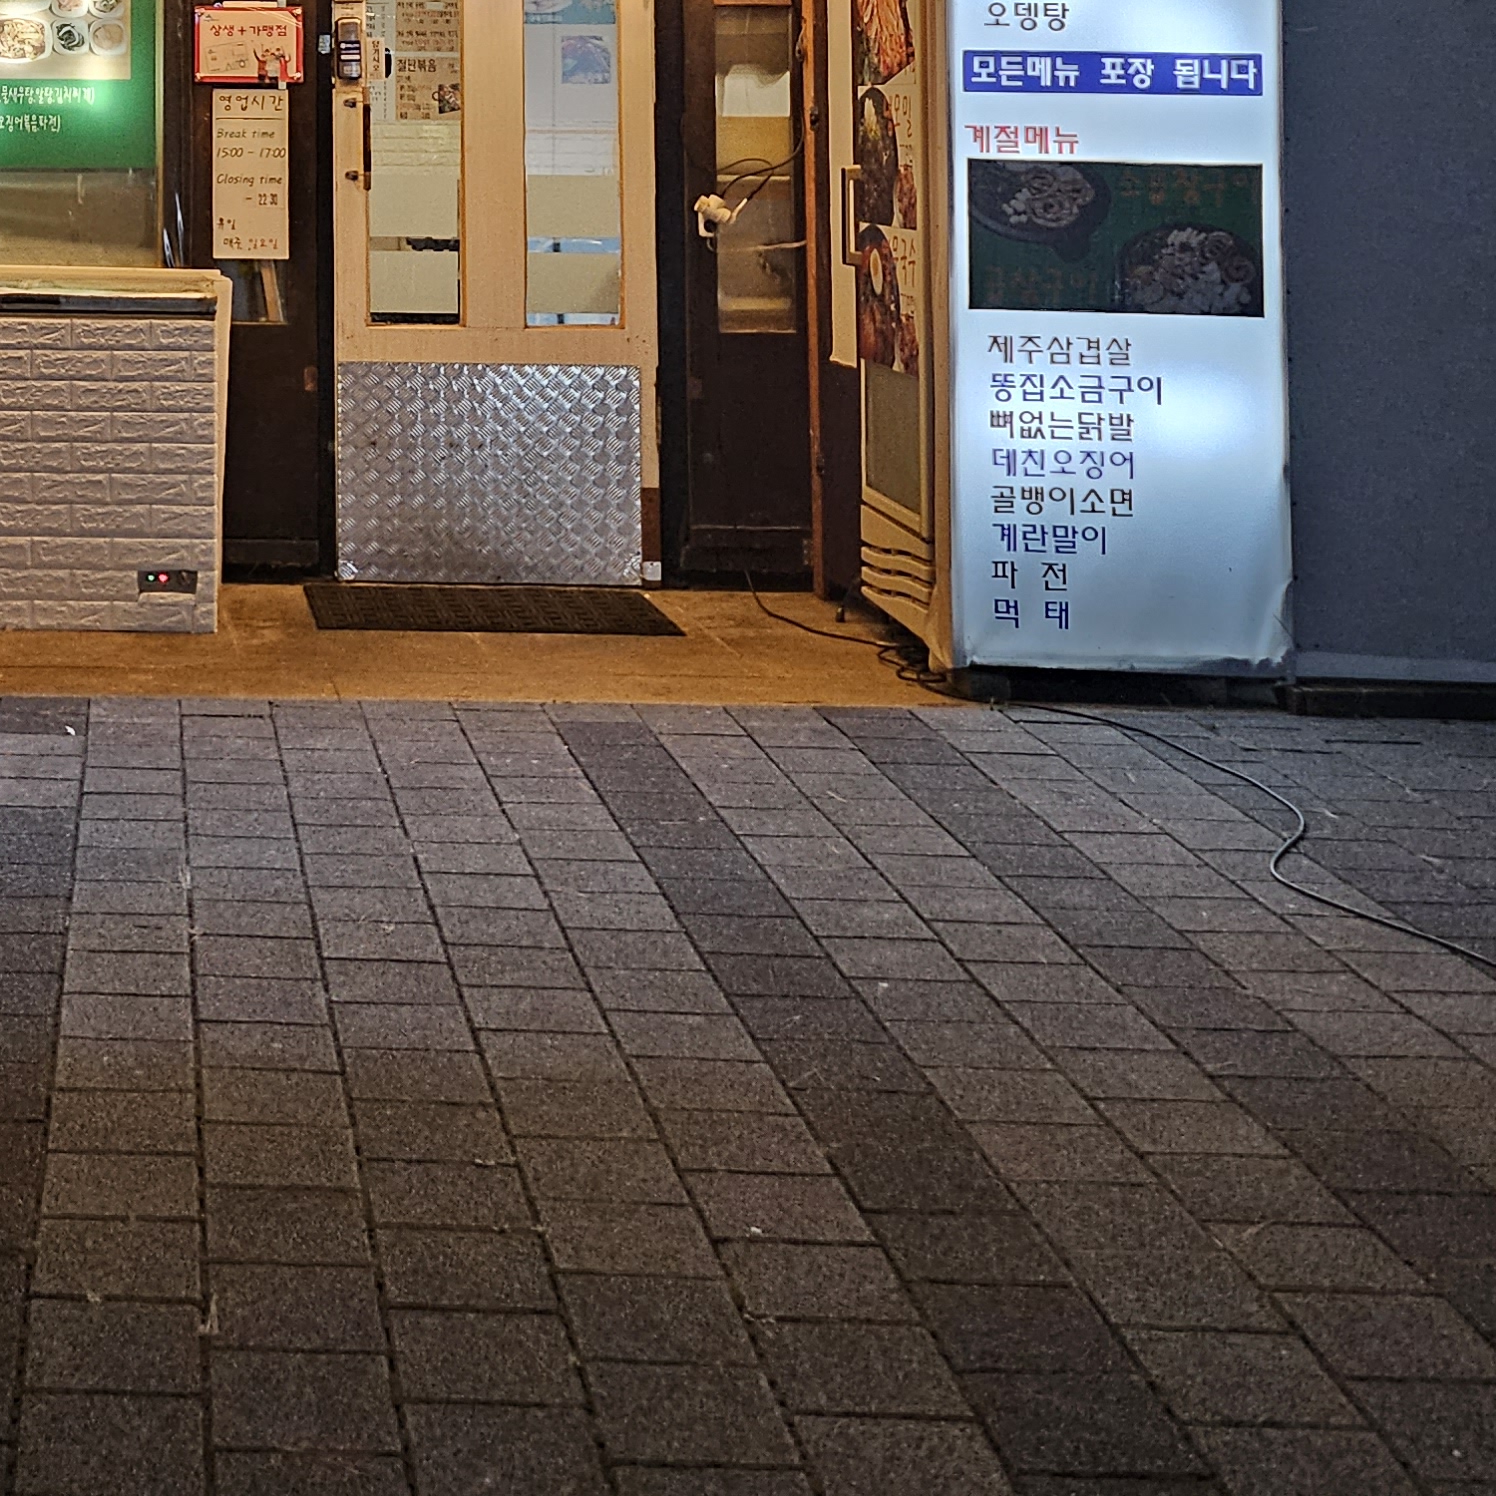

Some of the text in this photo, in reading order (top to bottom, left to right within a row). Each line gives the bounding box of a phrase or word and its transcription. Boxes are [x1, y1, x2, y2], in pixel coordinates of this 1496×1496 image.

[209, 24, 235, 37] 상생
[248, 24, 288, 37] 가맹점
[983, 2, 1071, 32] 오뎅탕
[970, 55, 1258, 91] 모든메뉴 포장 됩니다
[219, 95, 284, 112] 영업시간
[216, 128, 276, 139] Break time
[964, 124, 1080, 155] 계절메뉴
[216, 173, 283, 186] Closing time
[987, 334, 1132, 367] 제주삼겹살
[989, 372, 1163, 406] 똥집소금구이
[989, 410, 1135, 443] 뼈없는닭발
[992, 448, 1136, 481] 데친오징어
[990, 486, 1134, 518] 골뱅이소면
[992, 523, 1107, 555] 계란말이
